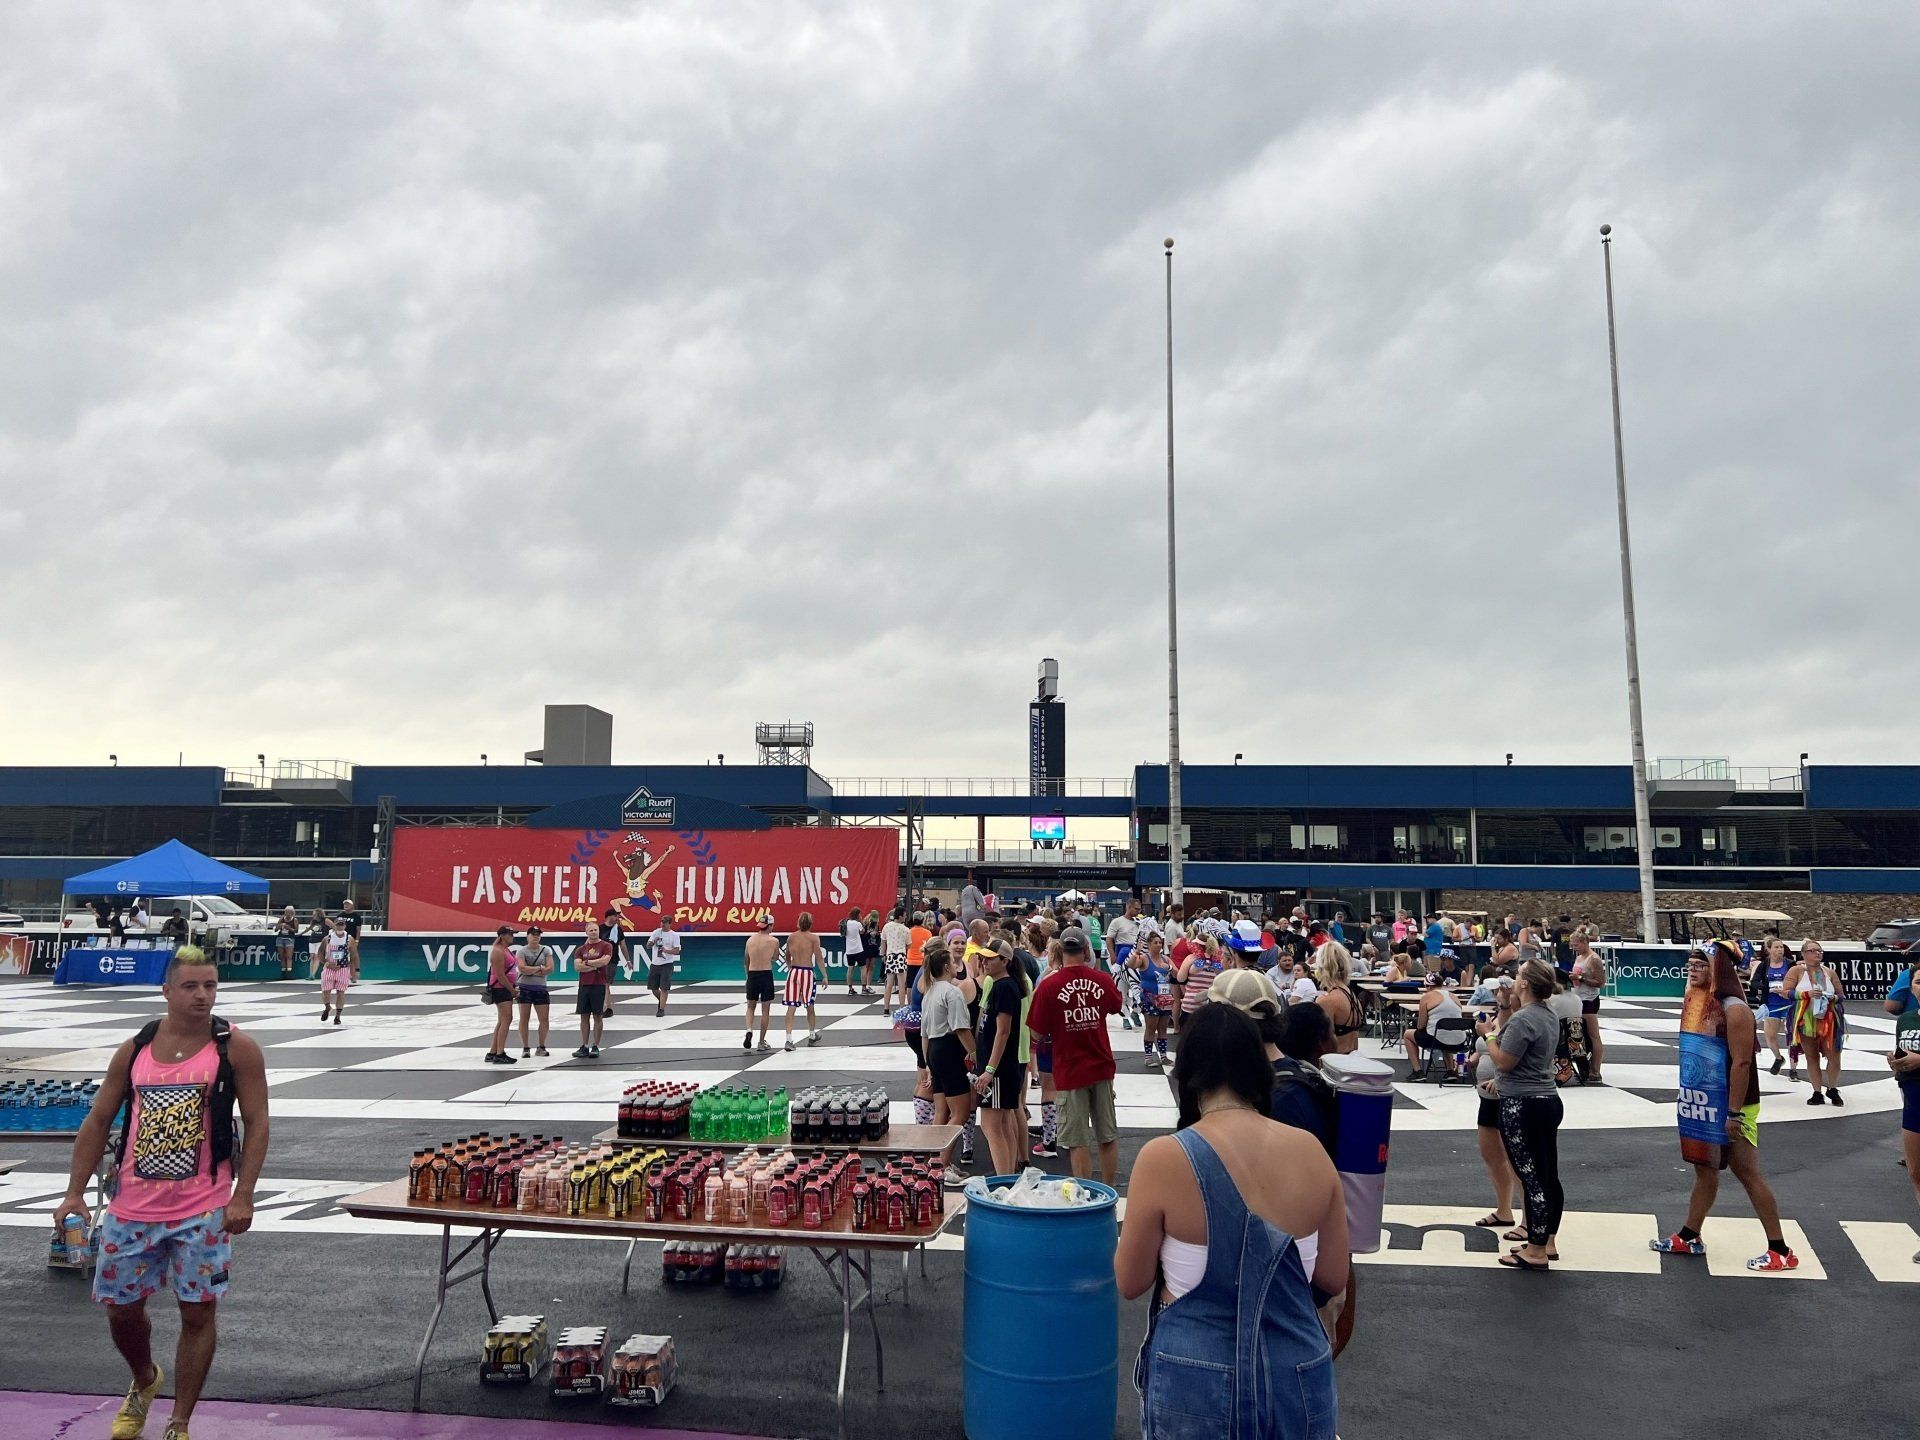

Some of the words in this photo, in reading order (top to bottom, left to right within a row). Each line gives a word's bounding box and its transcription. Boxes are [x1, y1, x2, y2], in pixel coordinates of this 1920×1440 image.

[648, 799, 672, 807] Ruoff
[451, 865, 598, 904] FASTER
[675, 866, 849, 904] HUMANS
[630, 880, 639, 888] 22
[517, 906, 598, 923] ANNUAL
[674, 906, 718, 923] FUN
[217, 946, 266, 966] uoff
[1609, 966, 1688, 979] MORTGAGE
[1057, 979, 1105, 1004] BISCUITS
[1845, 984, 1867, 992] INO
[1076, 992, 1088, 1007] N'
[1063, 1006, 1100, 1024] PORN
[1679, 1087, 1708, 1105] UD
[139, 1097, 202, 1123] PARTY
[1678, 1102, 1717, 1122] GHT
[139, 1124, 160, 1140] OF
[164, 1116, 201, 1138] THE
[132, 1130, 206, 1158] SUMMER
[51, 1256, 69, 1264] POWE
